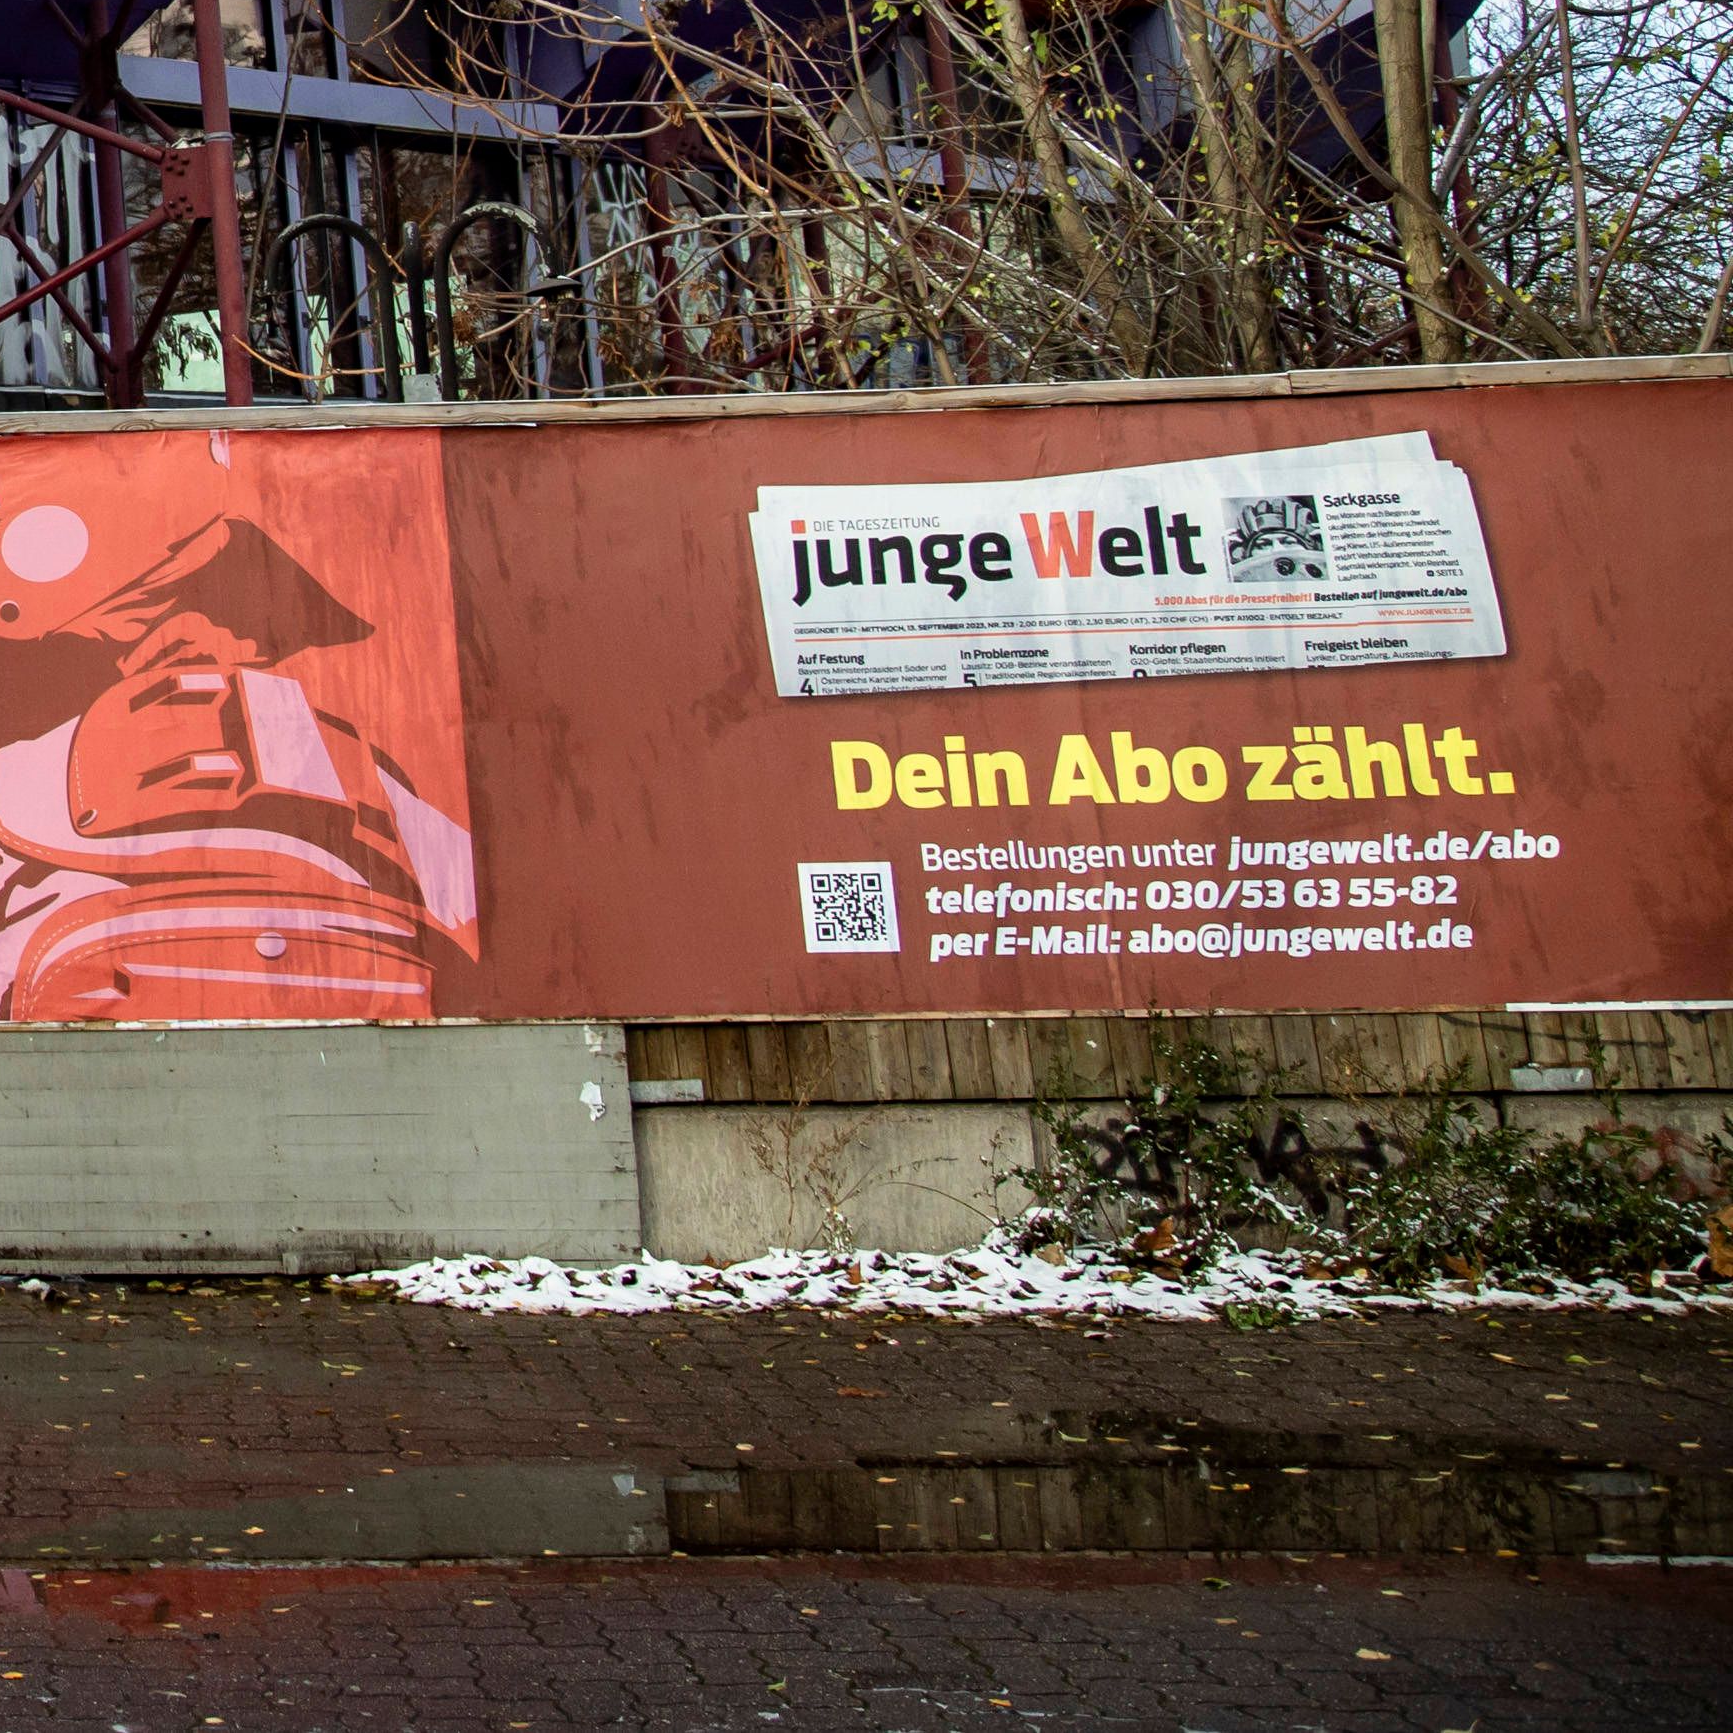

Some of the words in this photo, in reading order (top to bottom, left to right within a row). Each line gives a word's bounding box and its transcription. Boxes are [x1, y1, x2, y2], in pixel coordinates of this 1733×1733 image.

[1323, 493, 1400, 507] Sackgasse
[813, 520, 835, 532] DIE
[840, 516, 940, 531] TAGESZEITUNG
[792, 532, 1013, 607] junge
[1019, 505, 1207, 579] Welt
[1155, 596, 1183, 606] 5.000
[1209, 594, 1223, 606] für
[1224, 594, 1239, 604] die
[1314, 590, 1359, 602] Bestellen
[1361, 589, 1378, 601] auf
[1379, 587, 1468, 600] jungewelt.de/abo
[918, 622, 964, 631] SEPTEMBER
[961, 650, 971, 659] In
[974, 648, 1049, 659] Problemzone
[1129, 644, 1177, 655] Korridor
[1180, 643, 1226, 656] pflegen
[1305, 640, 1359, 652] Freigeist
[1361, 638, 1408, 649] bleiben
[797, 654, 816, 665] Auf
[819, 654, 865, 666] Festung
[800, 678, 814, 696] 4
[830, 735, 1031, 810] Dein
[1049, 730, 1229, 806] Abo
[1245, 722, 1516, 802] zählt.
[921, 839, 1125, 877] Bestellungen
[1133, 838, 1217, 867] unter
[1228, 829, 1560, 869] jungewelt.de/abo
[925, 880, 1138, 916] telefonisch:
[1146, 878, 1285, 912] 030/53
[1293, 877, 1341, 910] 63
[1347, 873, 1459, 908] 55-82
[930, 930, 989, 963] per
[995, 924, 1121, 956] E-Mail:
[1128, 920, 1473, 959] abo@jungewelt.de
